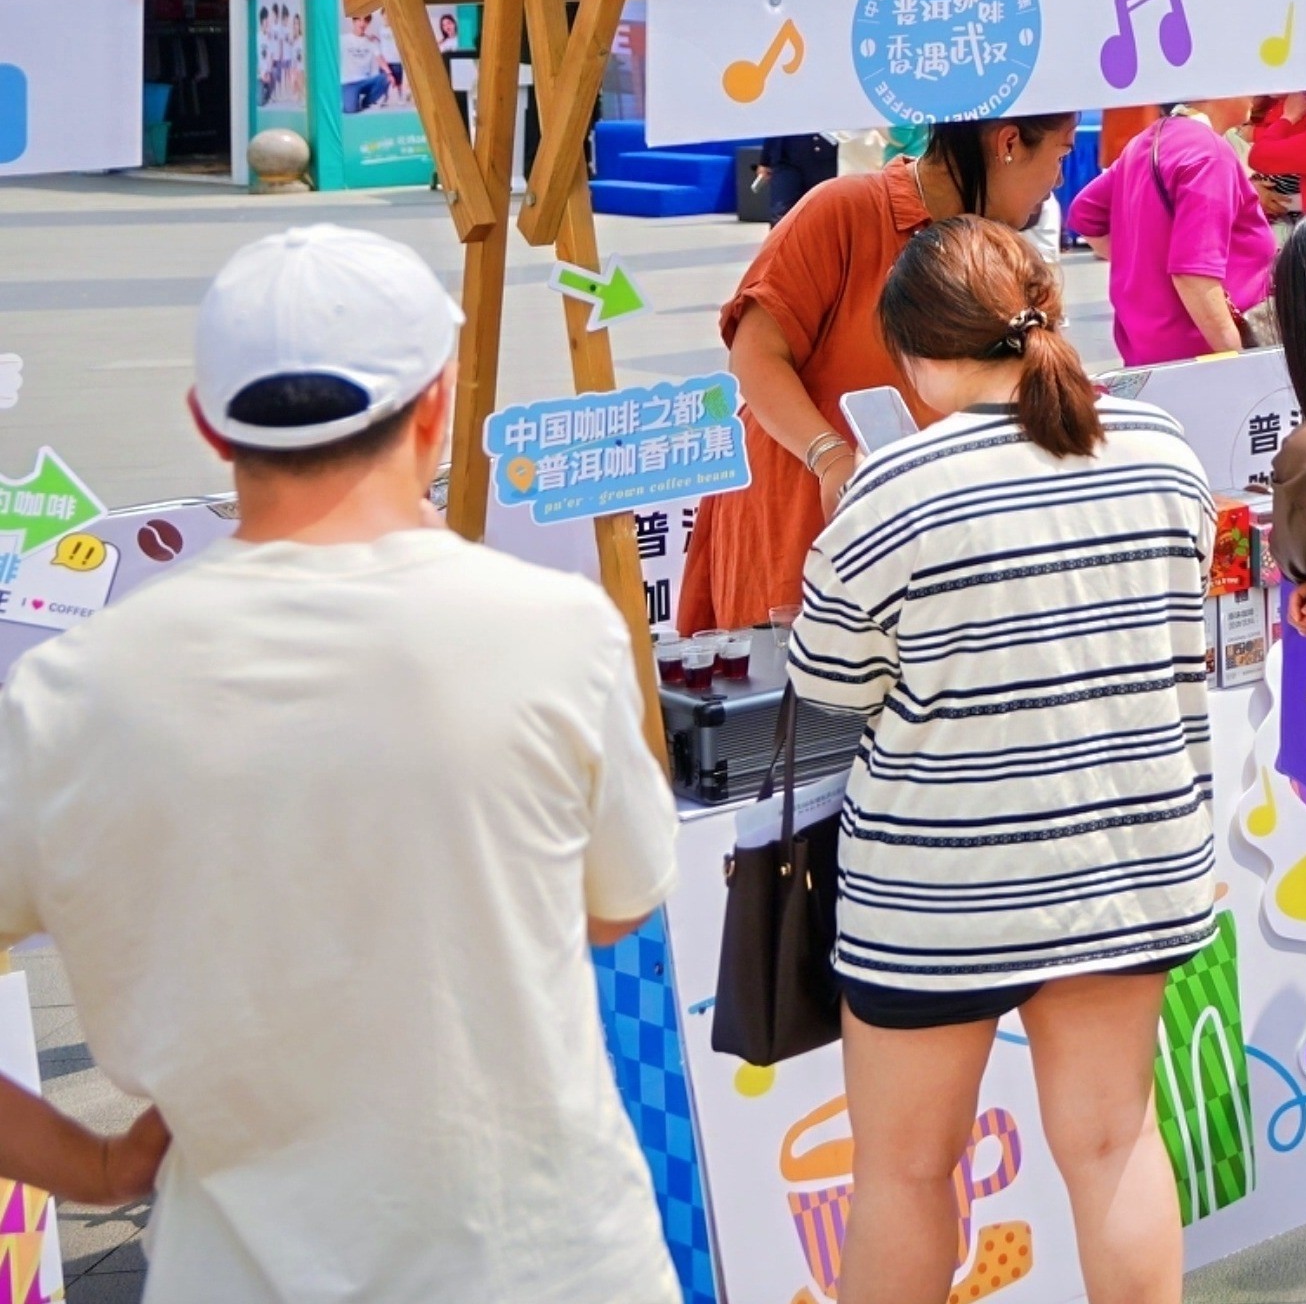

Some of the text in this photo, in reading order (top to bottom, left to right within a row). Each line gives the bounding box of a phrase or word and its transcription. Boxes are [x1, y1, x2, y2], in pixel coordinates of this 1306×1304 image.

[886, 21, 1008, 81] 香遇武汉
[504, 389, 705, 453] 中国咖啡之都
[536, 425, 735, 492] 普洱咖香市集
[600, 486, 645, 505] grown
[650, 475, 692, 493] coffee
[696, 469, 736, 485] beans
